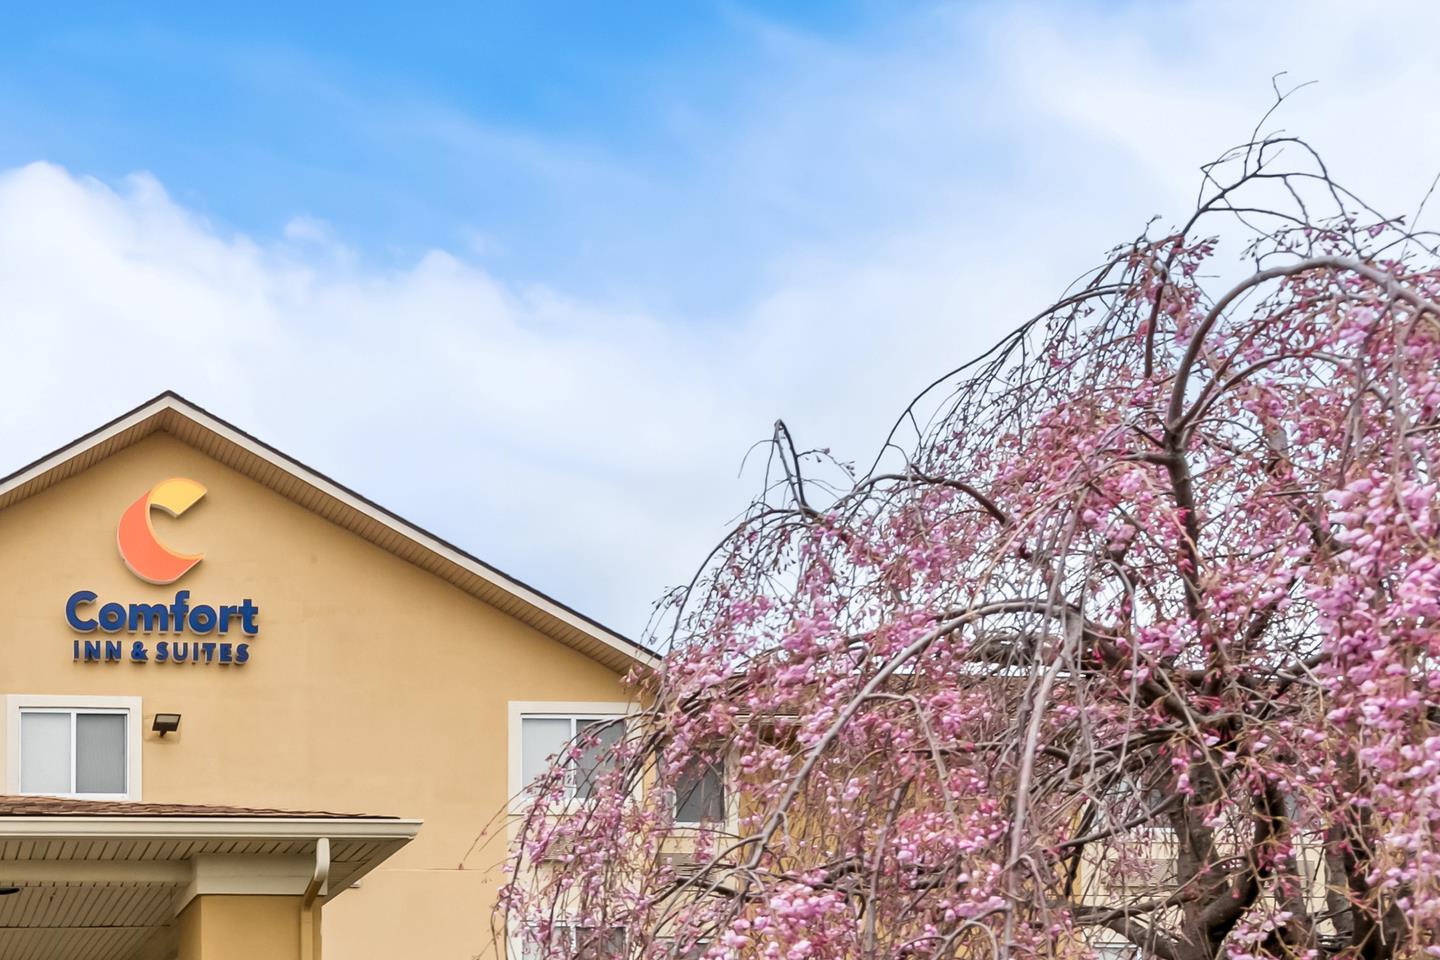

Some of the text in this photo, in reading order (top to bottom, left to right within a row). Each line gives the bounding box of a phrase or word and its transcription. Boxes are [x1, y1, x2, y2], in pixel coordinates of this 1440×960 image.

[65, 590, 259, 635] Comfort
[73, 640, 250, 664] INN & SUITES
